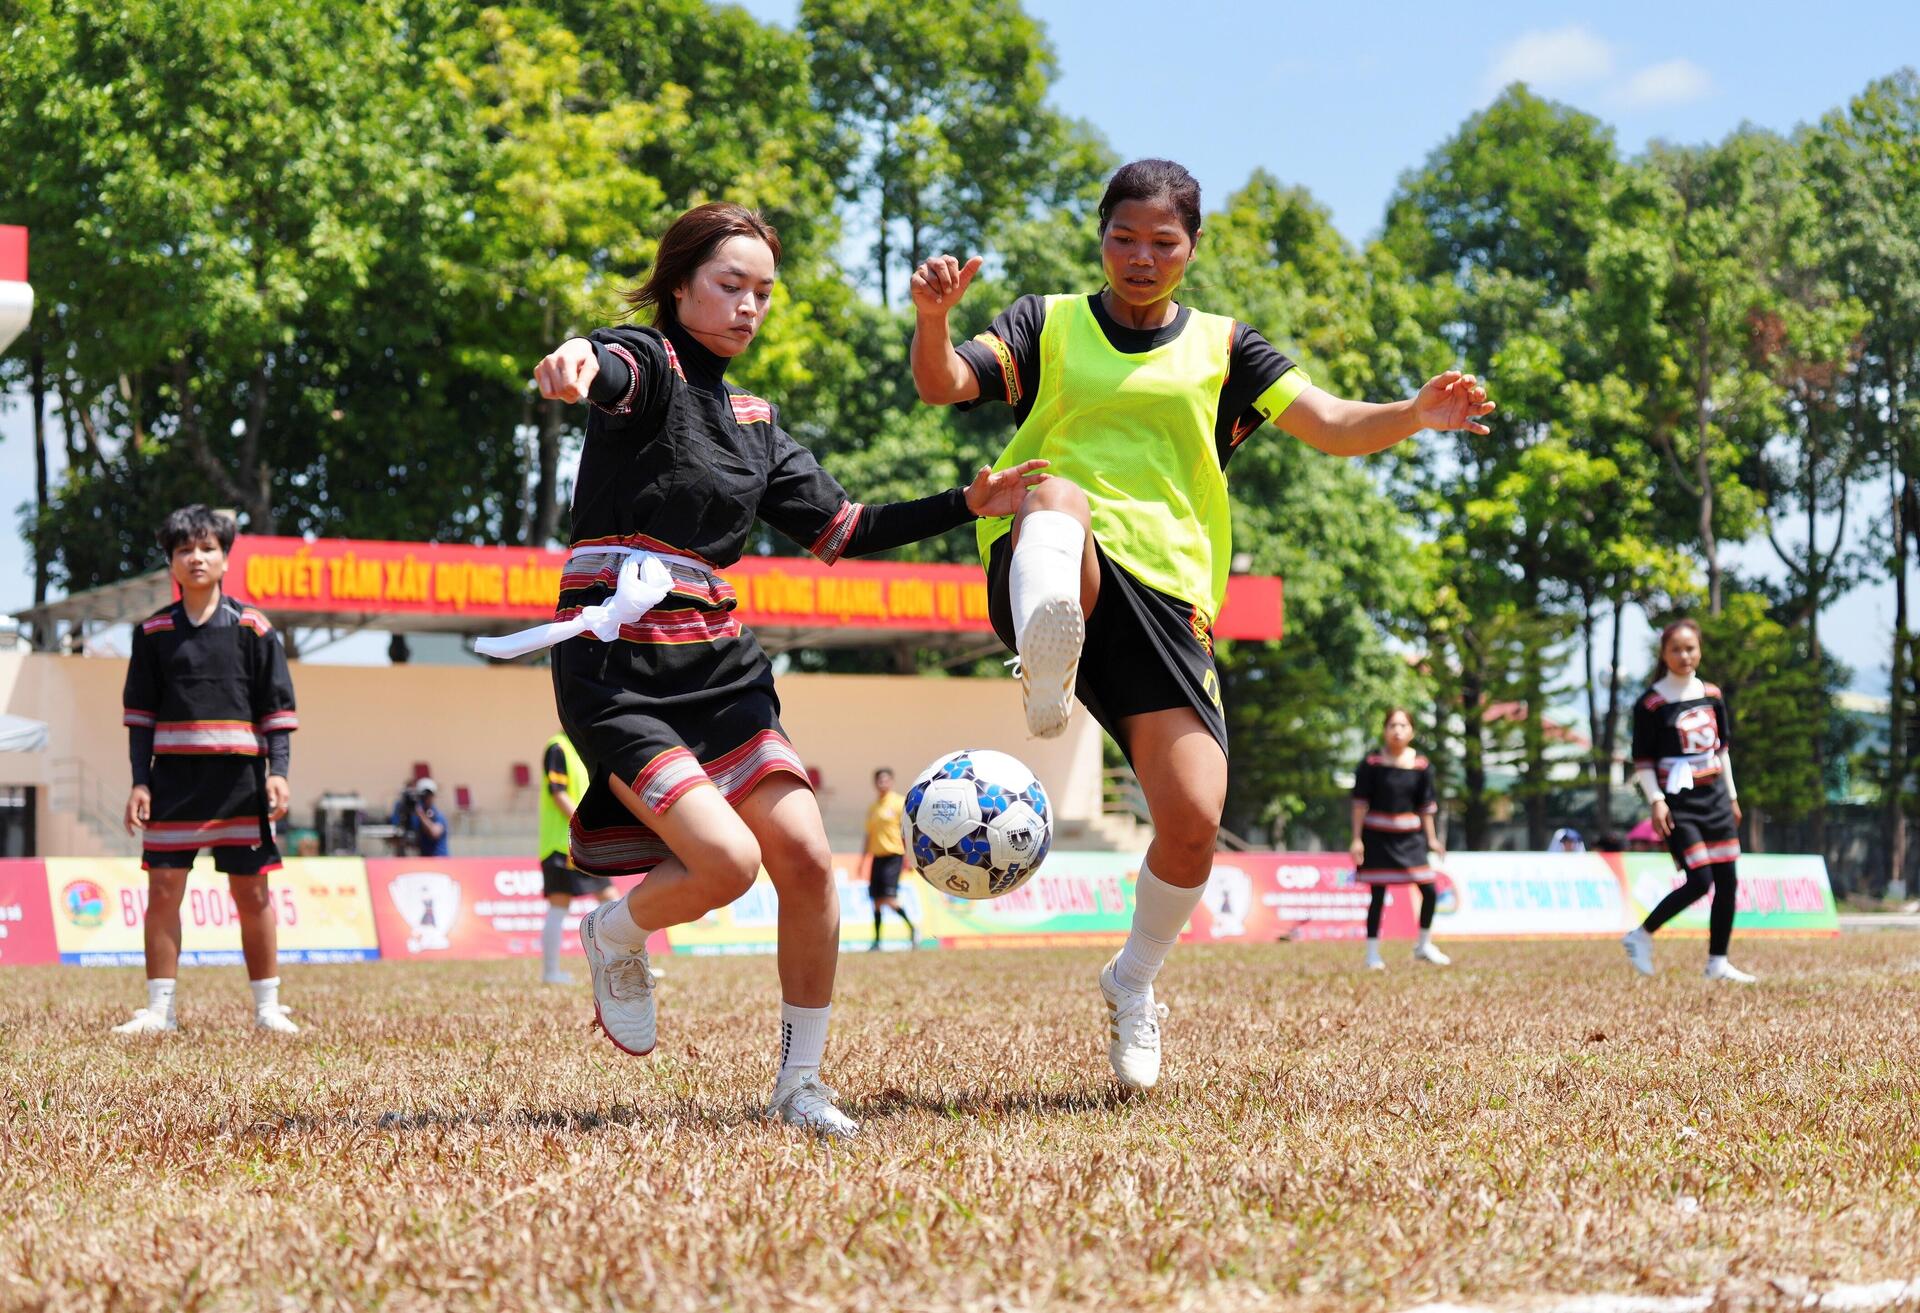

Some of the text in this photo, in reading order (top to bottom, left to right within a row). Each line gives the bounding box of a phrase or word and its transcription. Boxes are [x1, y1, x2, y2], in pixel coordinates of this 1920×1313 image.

[247, 546, 322, 600] QUYẾT
[329, 551, 381, 600] TÂM
[386, 552, 431, 602] XÂY
[436, 559, 503, 611] DỰNG
[507, 553, 560, 605] ĐẢN
